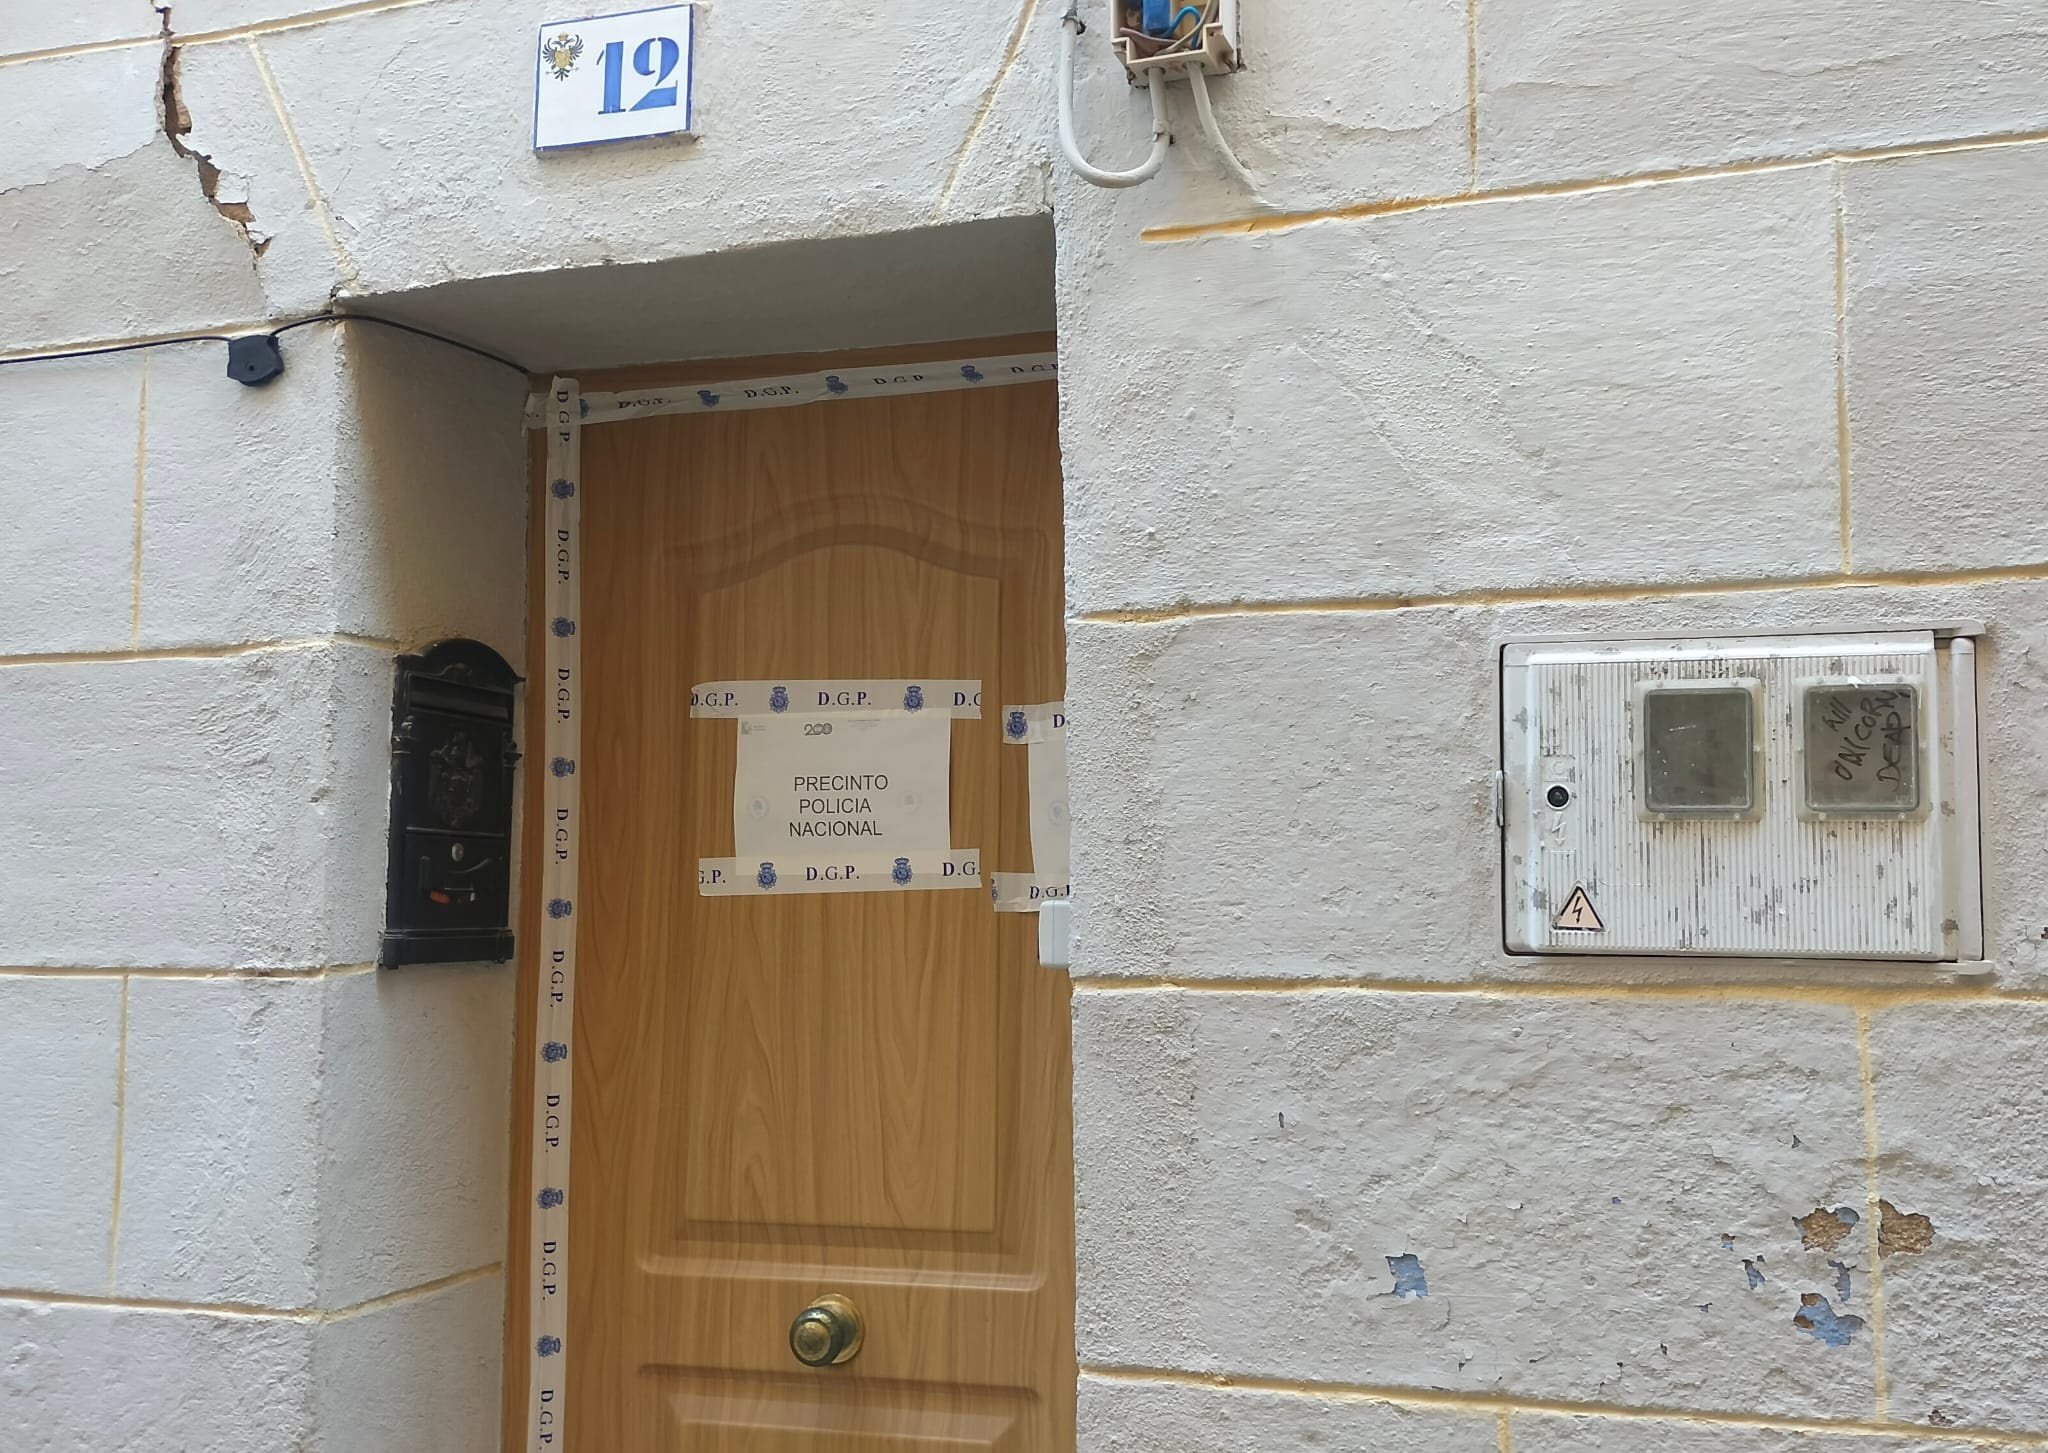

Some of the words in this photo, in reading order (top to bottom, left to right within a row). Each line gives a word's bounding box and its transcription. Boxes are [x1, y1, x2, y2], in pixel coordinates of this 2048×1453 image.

[595, 36, 680, 115] 12
[744, 384, 799, 399] D.G.P.
[557, 529, 570, 585] D.G.P.
[557, 667, 570, 724] D.G.P.
[817, 691, 872, 707] D.G.P.
[794, 774, 889, 792] PRECINTO
[799, 797, 872, 815] POLICIA
[555, 808, 569, 865] D.G.P.
[789, 820, 883, 837] NACIONAL
[806, 865, 860, 881] D.G.P.
[550, 950, 565, 1008] D.G.P.
[545, 1094, 560, 1152] D.G.P.
[542, 1241, 557, 1300] D.G.P.
[539, 1389, 554, 1450] D.G.P.
